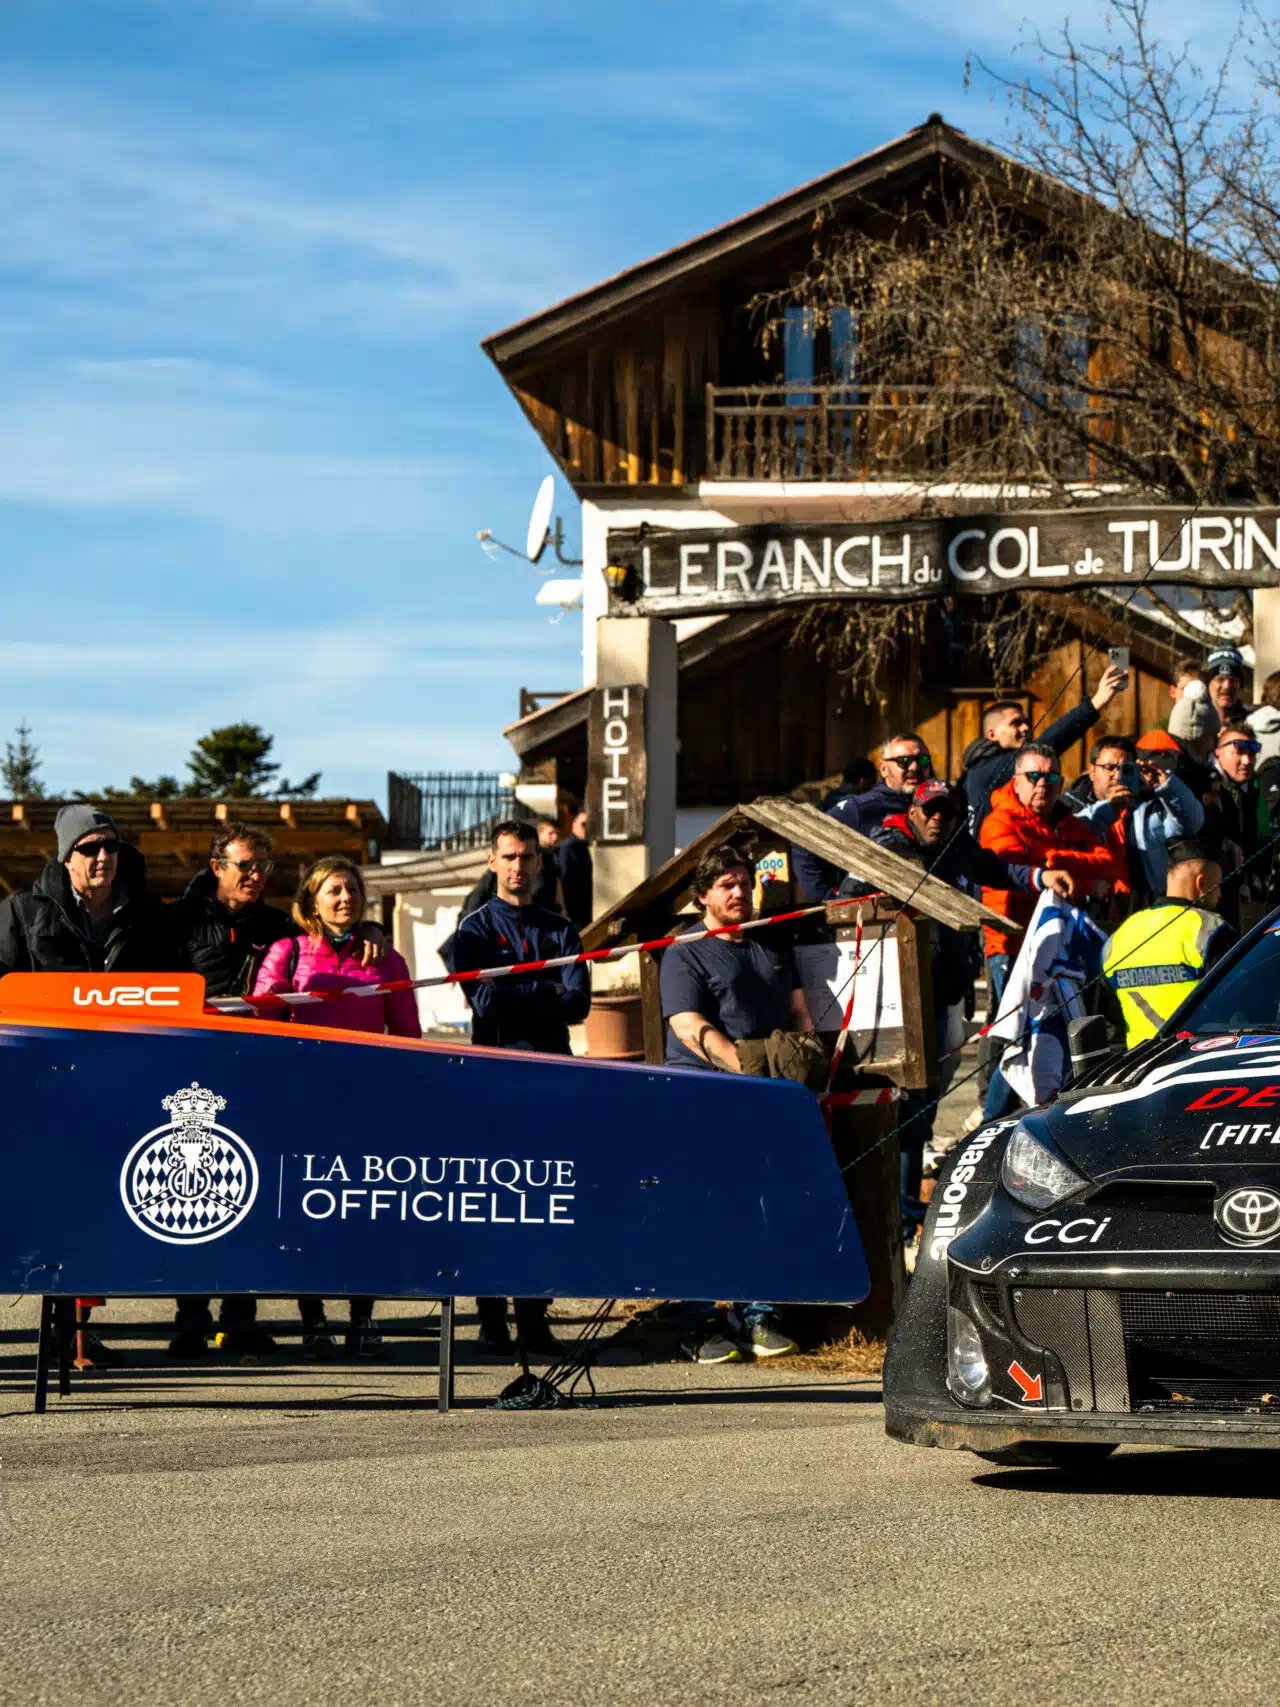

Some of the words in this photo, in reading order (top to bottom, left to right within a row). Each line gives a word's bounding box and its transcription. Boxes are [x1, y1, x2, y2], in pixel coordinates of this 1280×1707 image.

[912, 552, 943, 585] du
[947, 526, 1070, 582] COL
[1074, 547, 1105, 576] de
[602, 687, 630, 841] HOTEL
[72, 984, 181, 1006] WRC
[1116, 965, 1188, 988] GENDARMERIE
[302, 1154, 350, 1182] LA
[362, 1154, 577, 1194] BOUTIQUE
[930, 1119, 1020, 1262] Panasonic
[301, 1189, 576, 1224] OFFICIELLE
